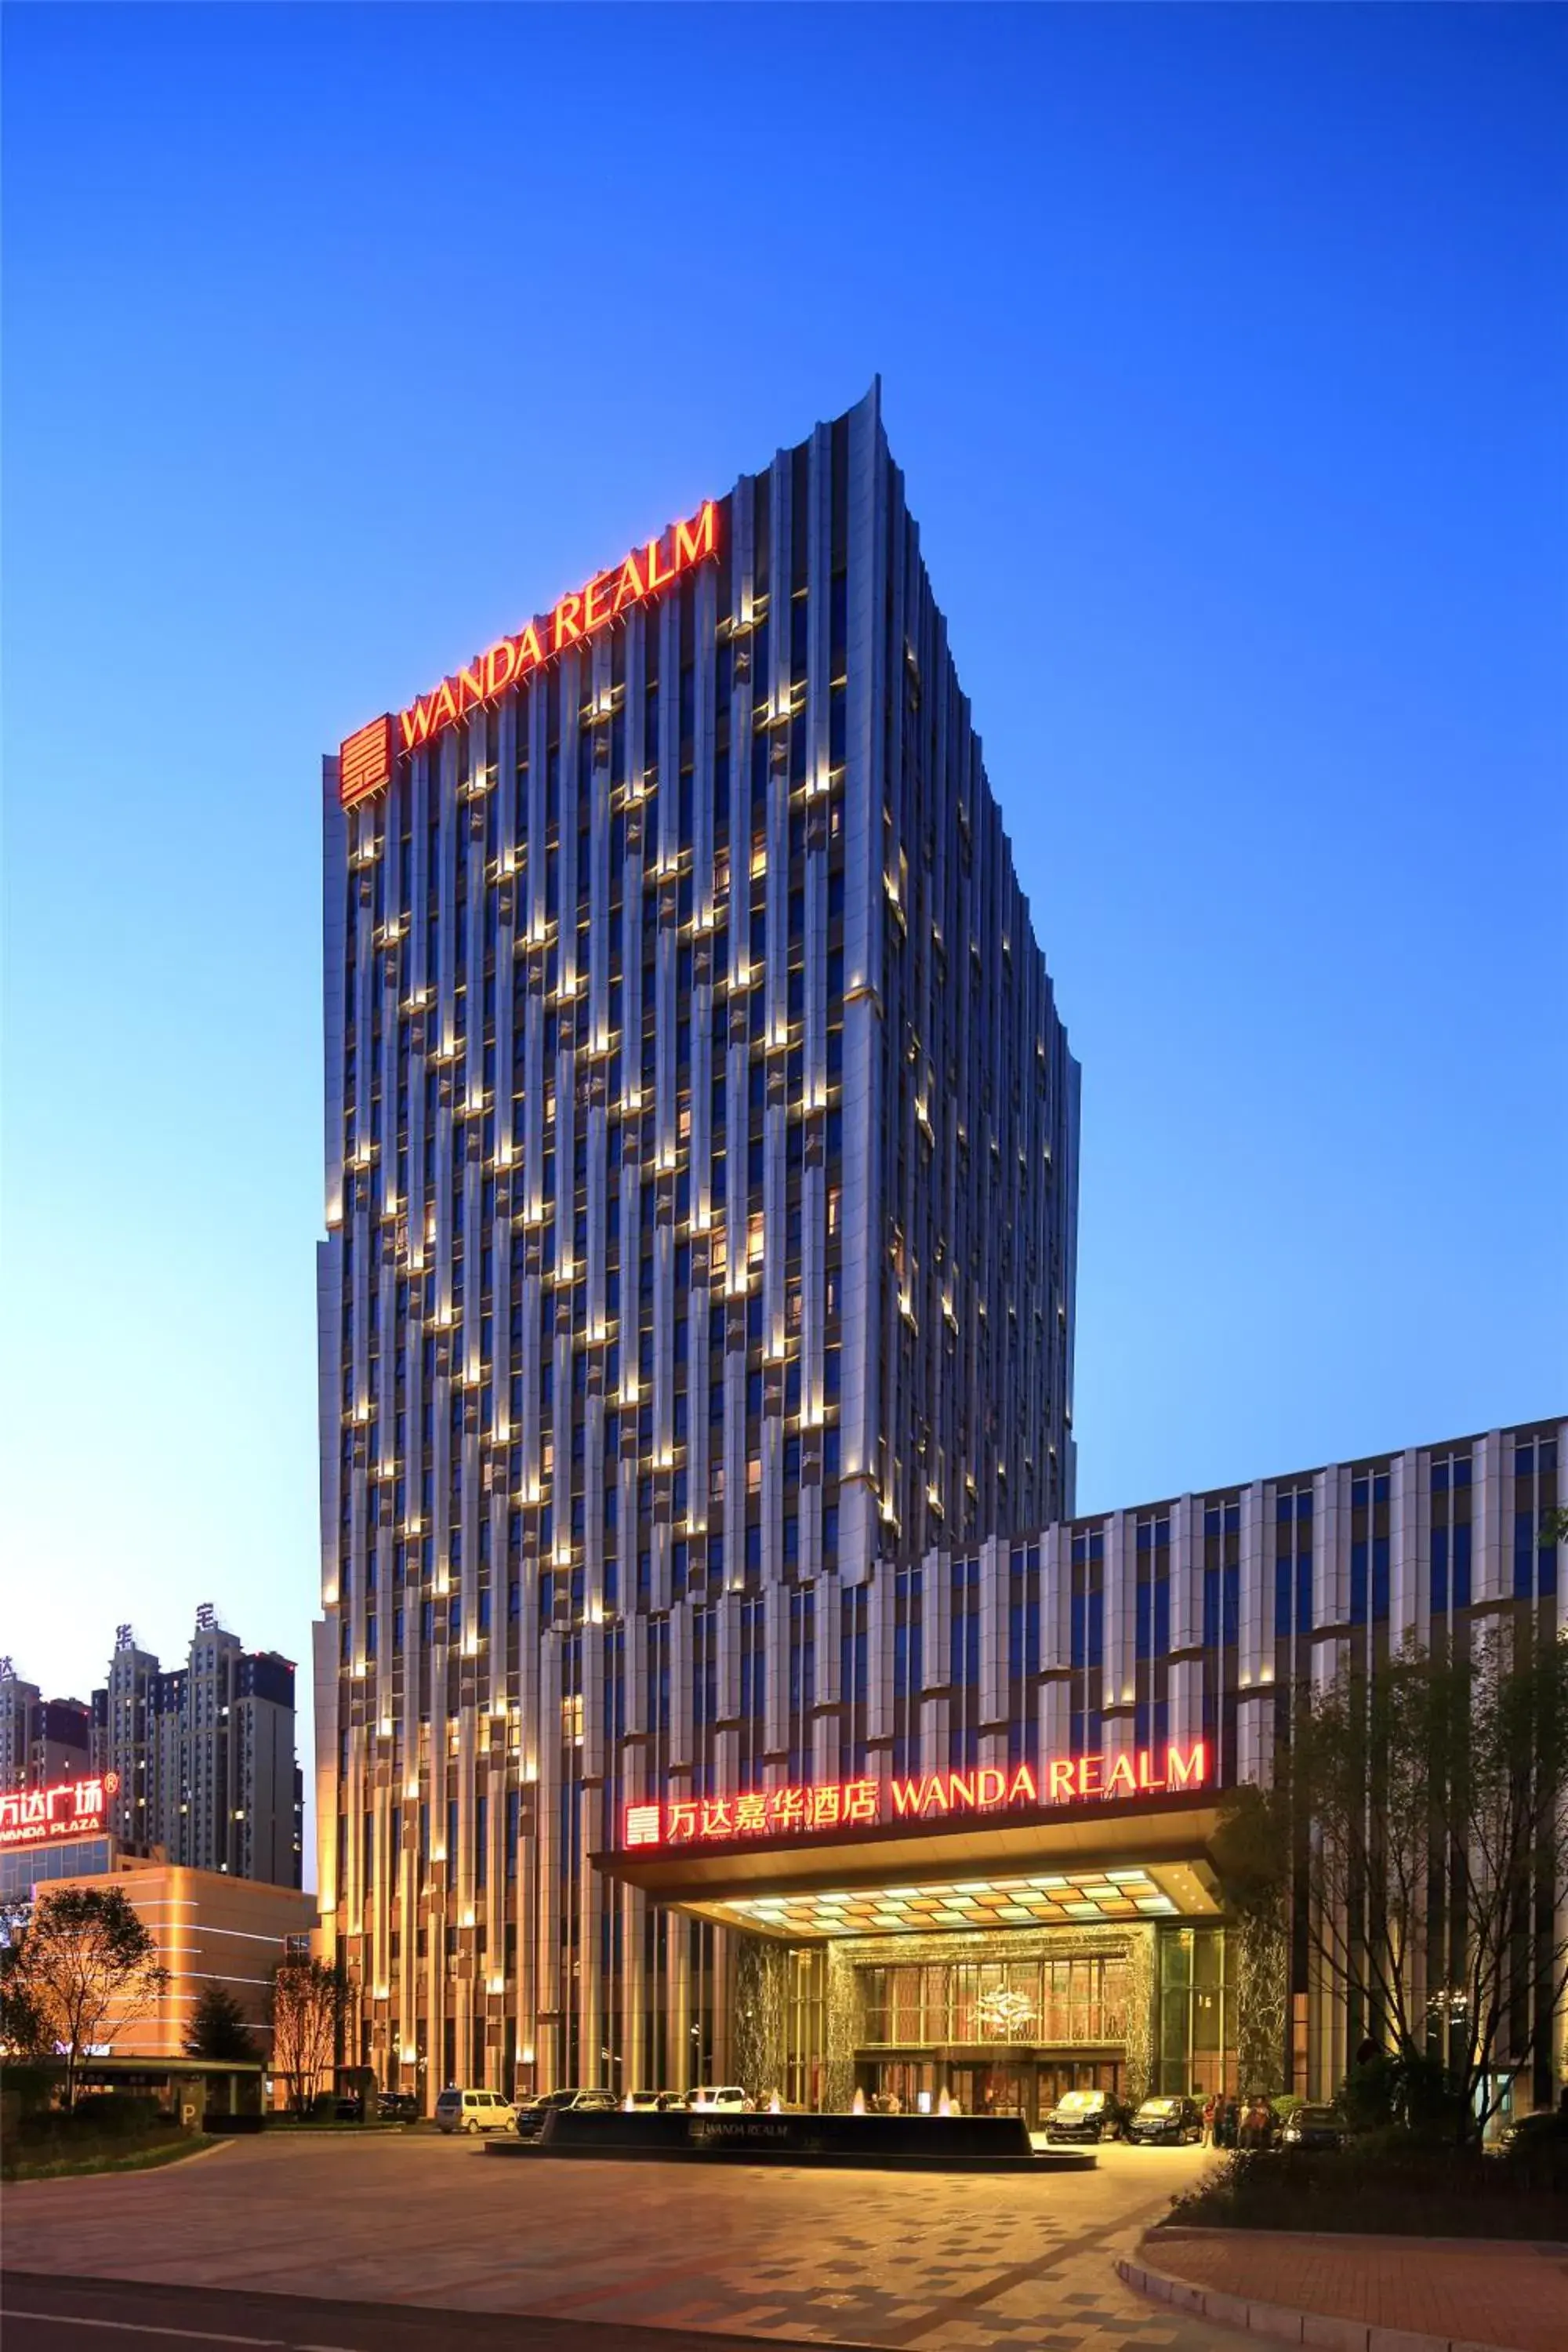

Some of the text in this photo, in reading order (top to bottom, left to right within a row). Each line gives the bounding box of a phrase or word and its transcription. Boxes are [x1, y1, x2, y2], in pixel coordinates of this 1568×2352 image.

[400, 500, 713, 749] WANDA REALM
[0, 1779, 103, 1825] 万达广场
[666, 1743, 1204, 1839] 万达嘉华酒店 WANDA REALM
[50, 1817, 100, 1835] PLAZA
[183, 2104, 195, 2125] P
[706, 2122, 788, 2138] WANDA REALM
